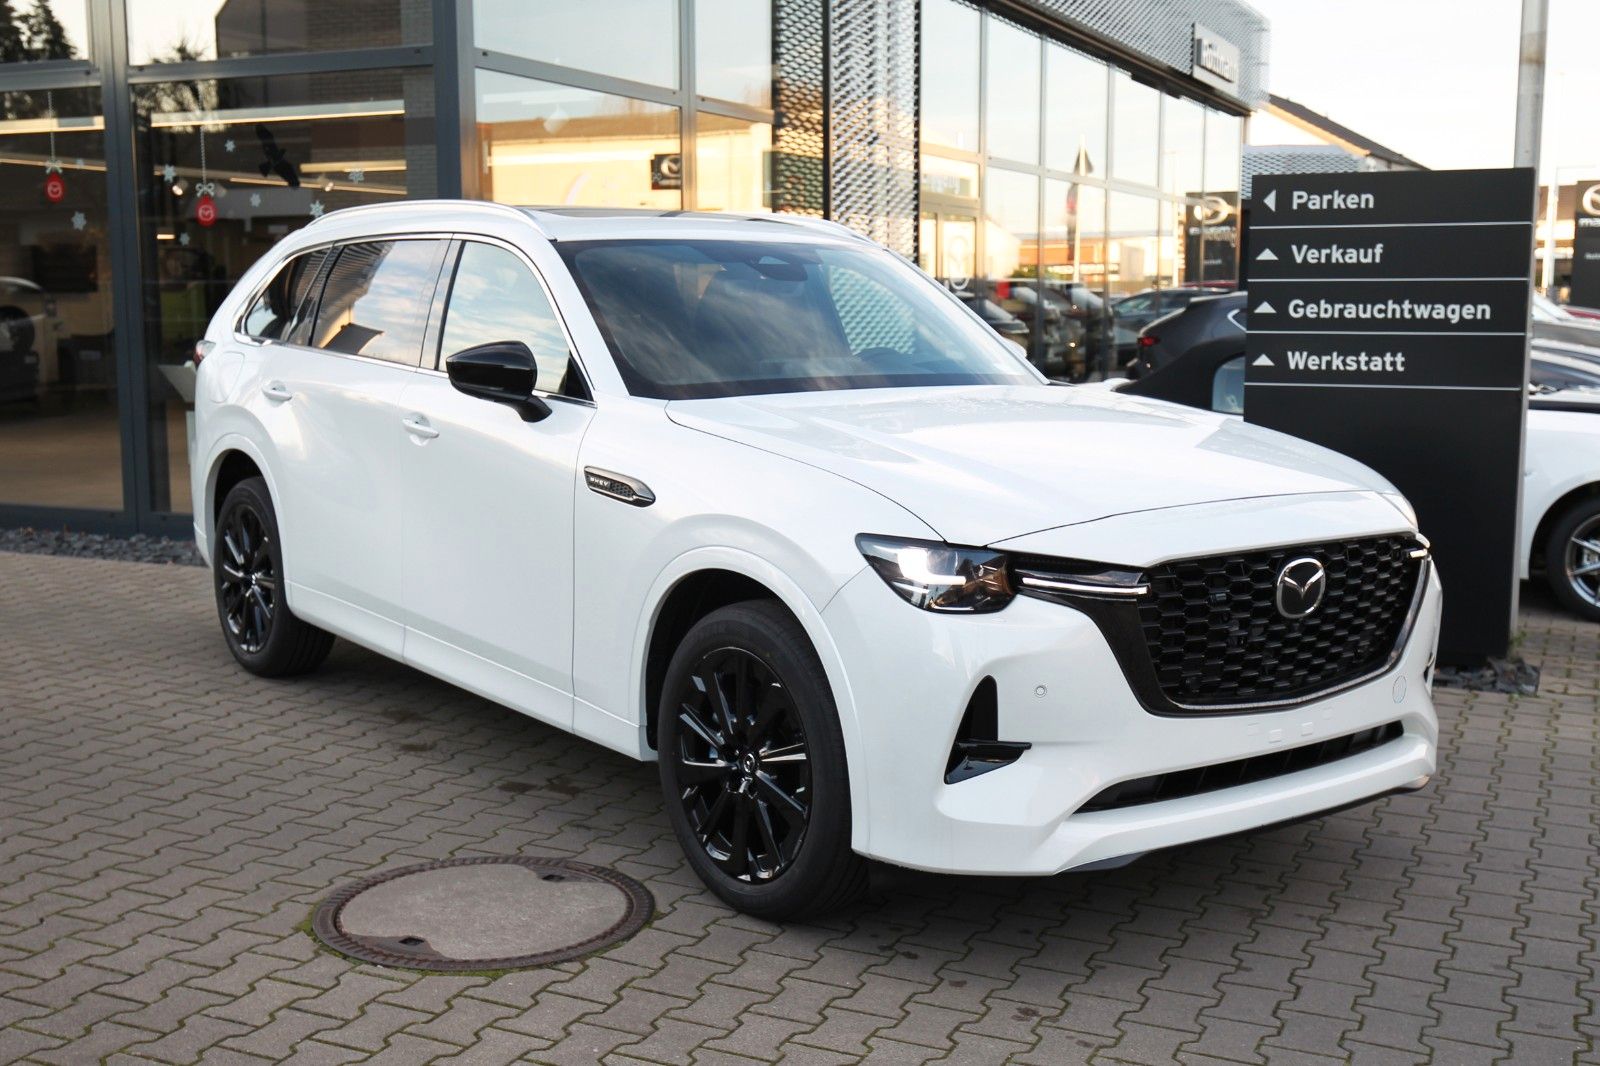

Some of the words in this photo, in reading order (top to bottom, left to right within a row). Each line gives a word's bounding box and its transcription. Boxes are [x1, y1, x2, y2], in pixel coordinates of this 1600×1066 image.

[1292, 190, 1375, 210] Parken
[1291, 244, 1384, 264] Verkauf
[1288, 299, 1491, 324] Gebrauchtwagen
[1287, 351, 1406, 372] Werkstatt
